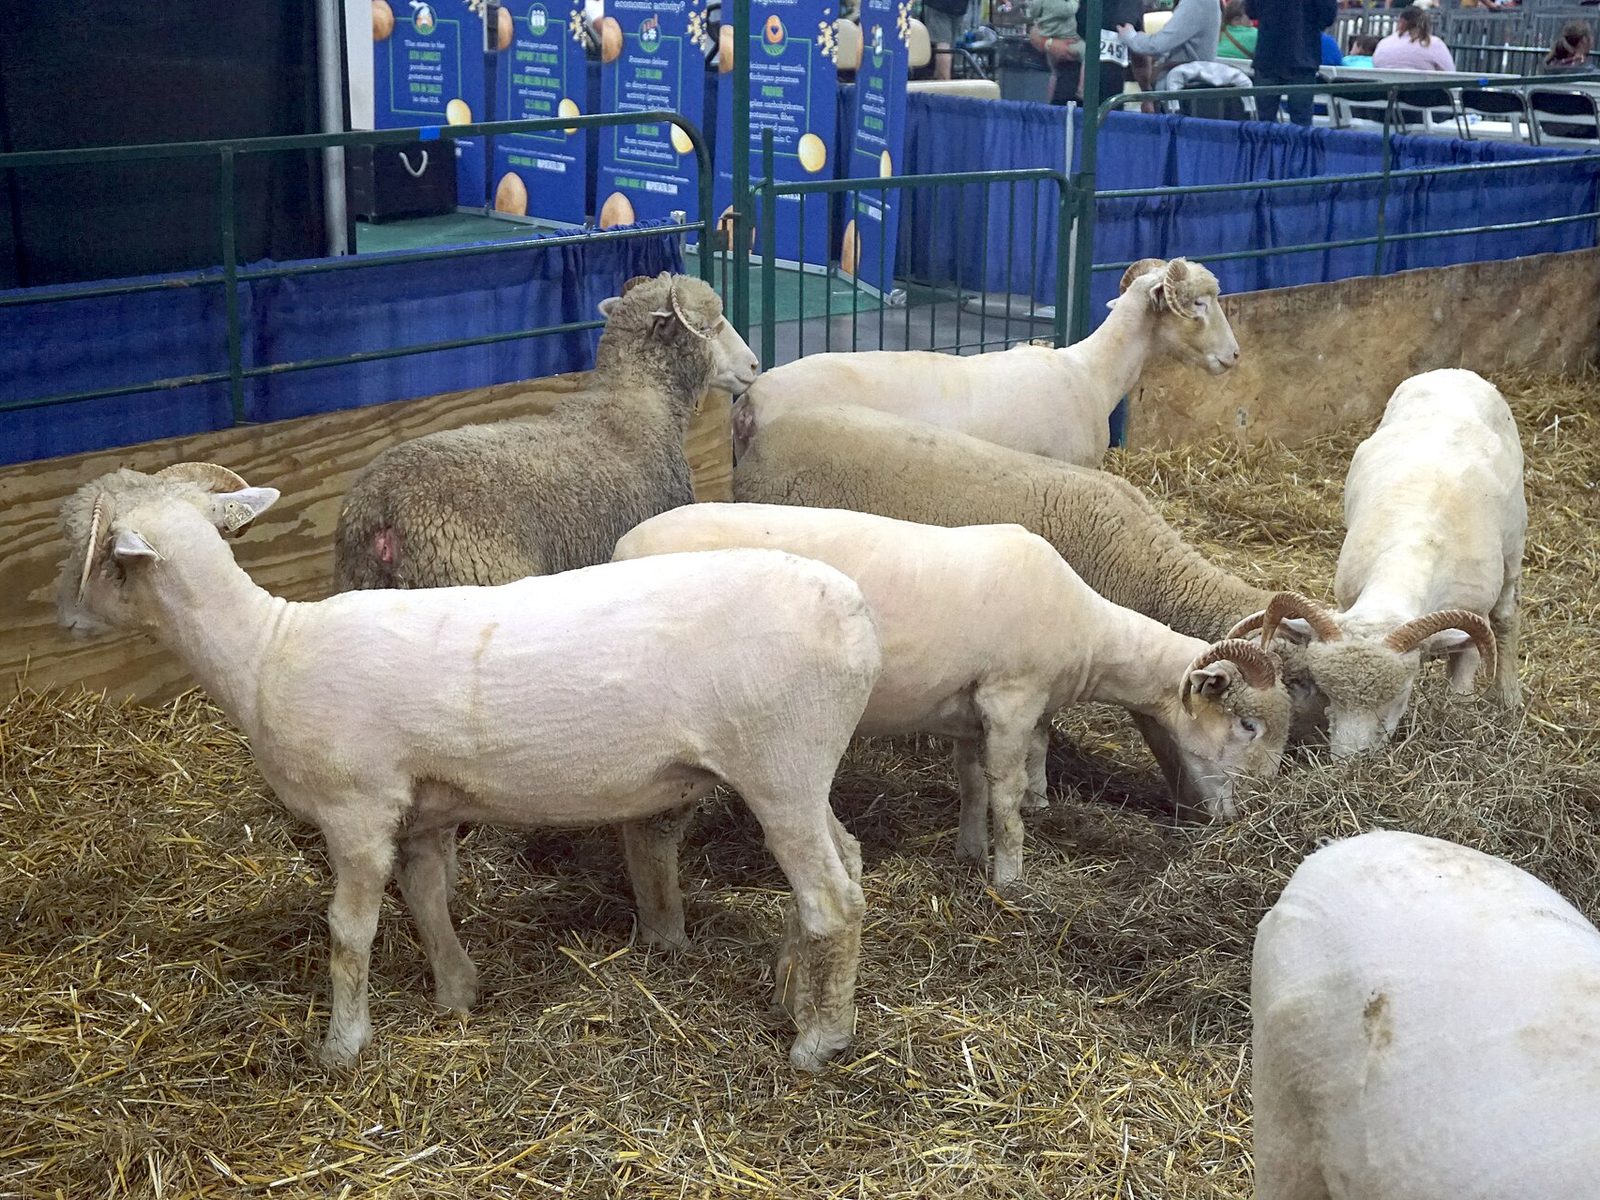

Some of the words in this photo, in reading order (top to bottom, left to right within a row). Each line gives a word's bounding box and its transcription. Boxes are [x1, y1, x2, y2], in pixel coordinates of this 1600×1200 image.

[614, 0, 652, 9] economic
[653, 2, 686, 13] activity?
[1100, 41, 1124, 59] 245
[749, 72, 774, 82] ichigan
[775, 76, 799, 84] potatoes
